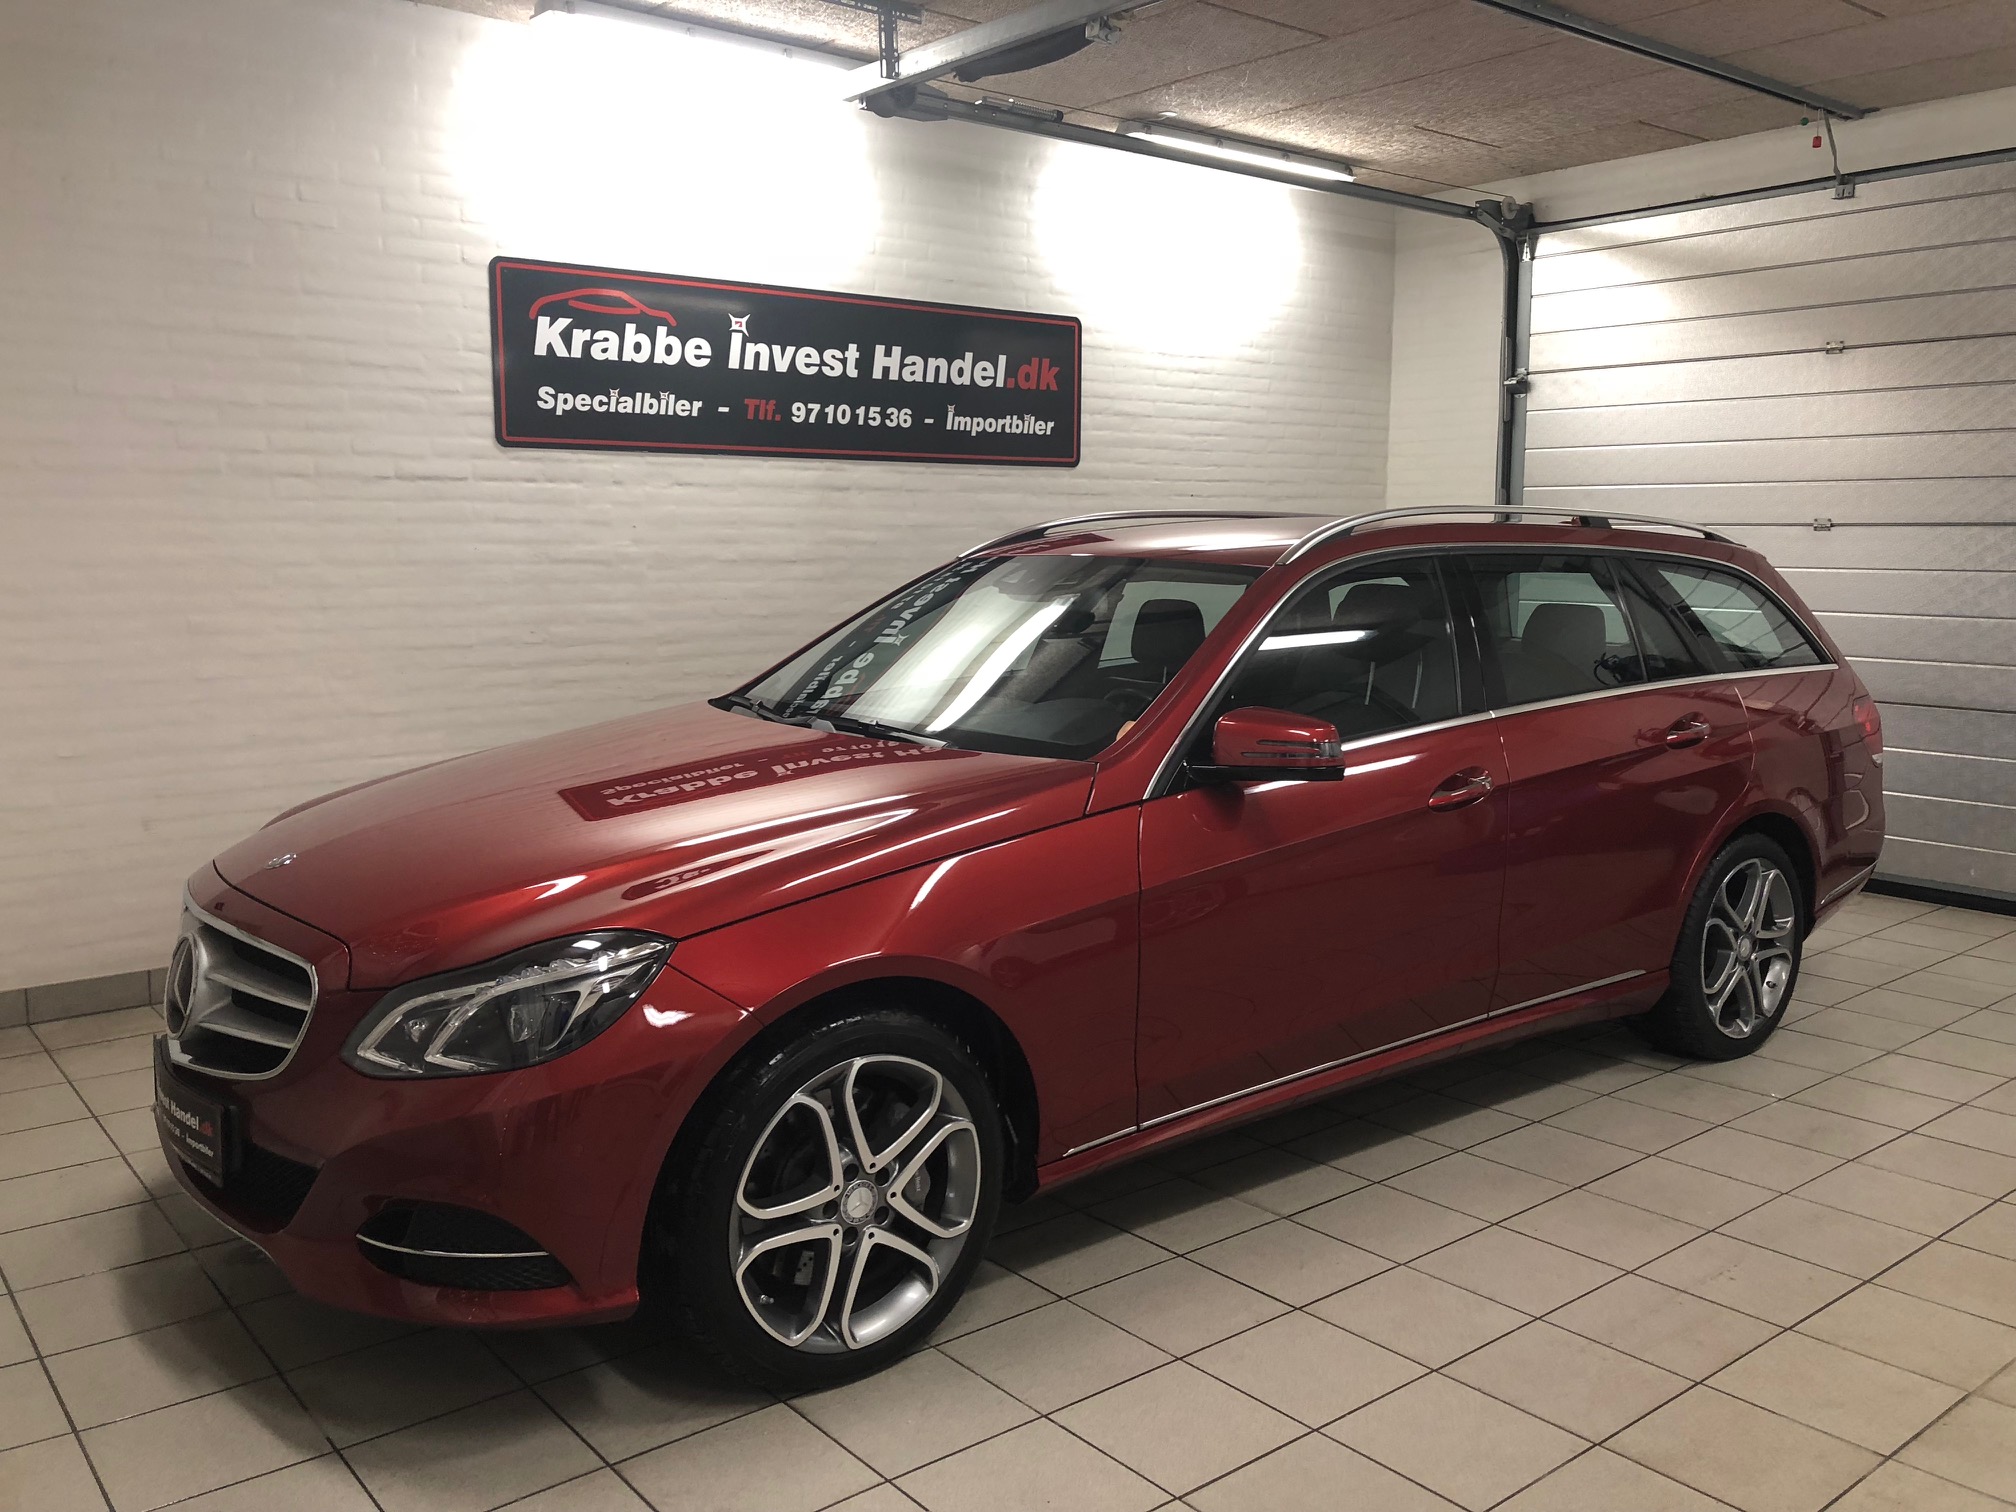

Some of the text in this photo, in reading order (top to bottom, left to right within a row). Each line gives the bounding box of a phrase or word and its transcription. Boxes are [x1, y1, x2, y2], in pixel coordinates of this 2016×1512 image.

[533, 313, 1061, 392] Krabbe Invest Handel.dk
[536, 386, 703, 417] Specialbiler
[717, 405, 730, 413] -
[744, 398, 782, 422] Tlf.
[923, 417, 935, 425] -
[945, 403, 1055, 437] Importbiler
